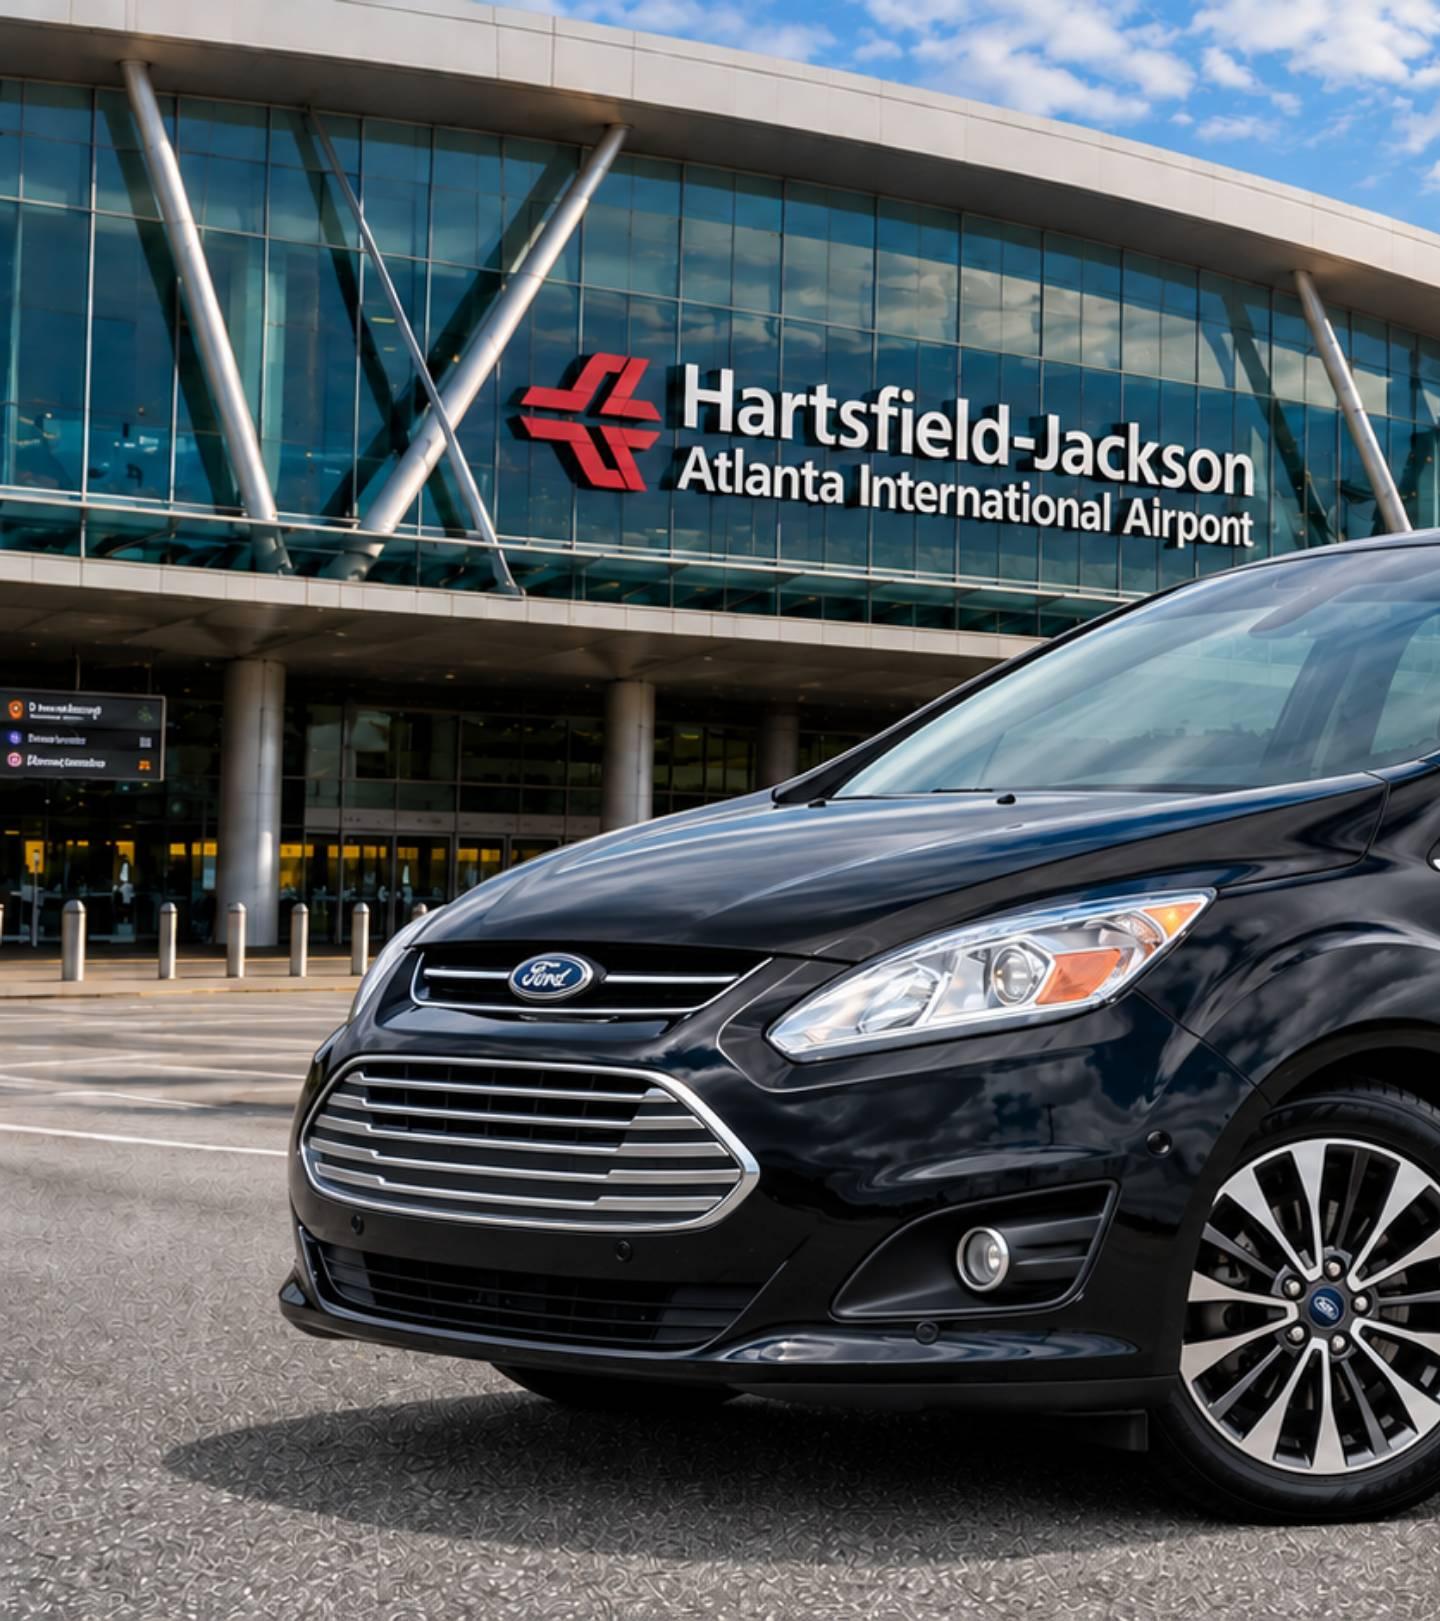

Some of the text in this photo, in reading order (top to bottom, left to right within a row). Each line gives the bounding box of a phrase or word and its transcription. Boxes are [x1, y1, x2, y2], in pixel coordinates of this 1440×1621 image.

[684, 363, 1255, 497] Hartsfield-Jackson
[677, 446, 844, 504] Atlanta
[860, 464, 1112, 533] International
[521, 961, 572, 987] Ford
